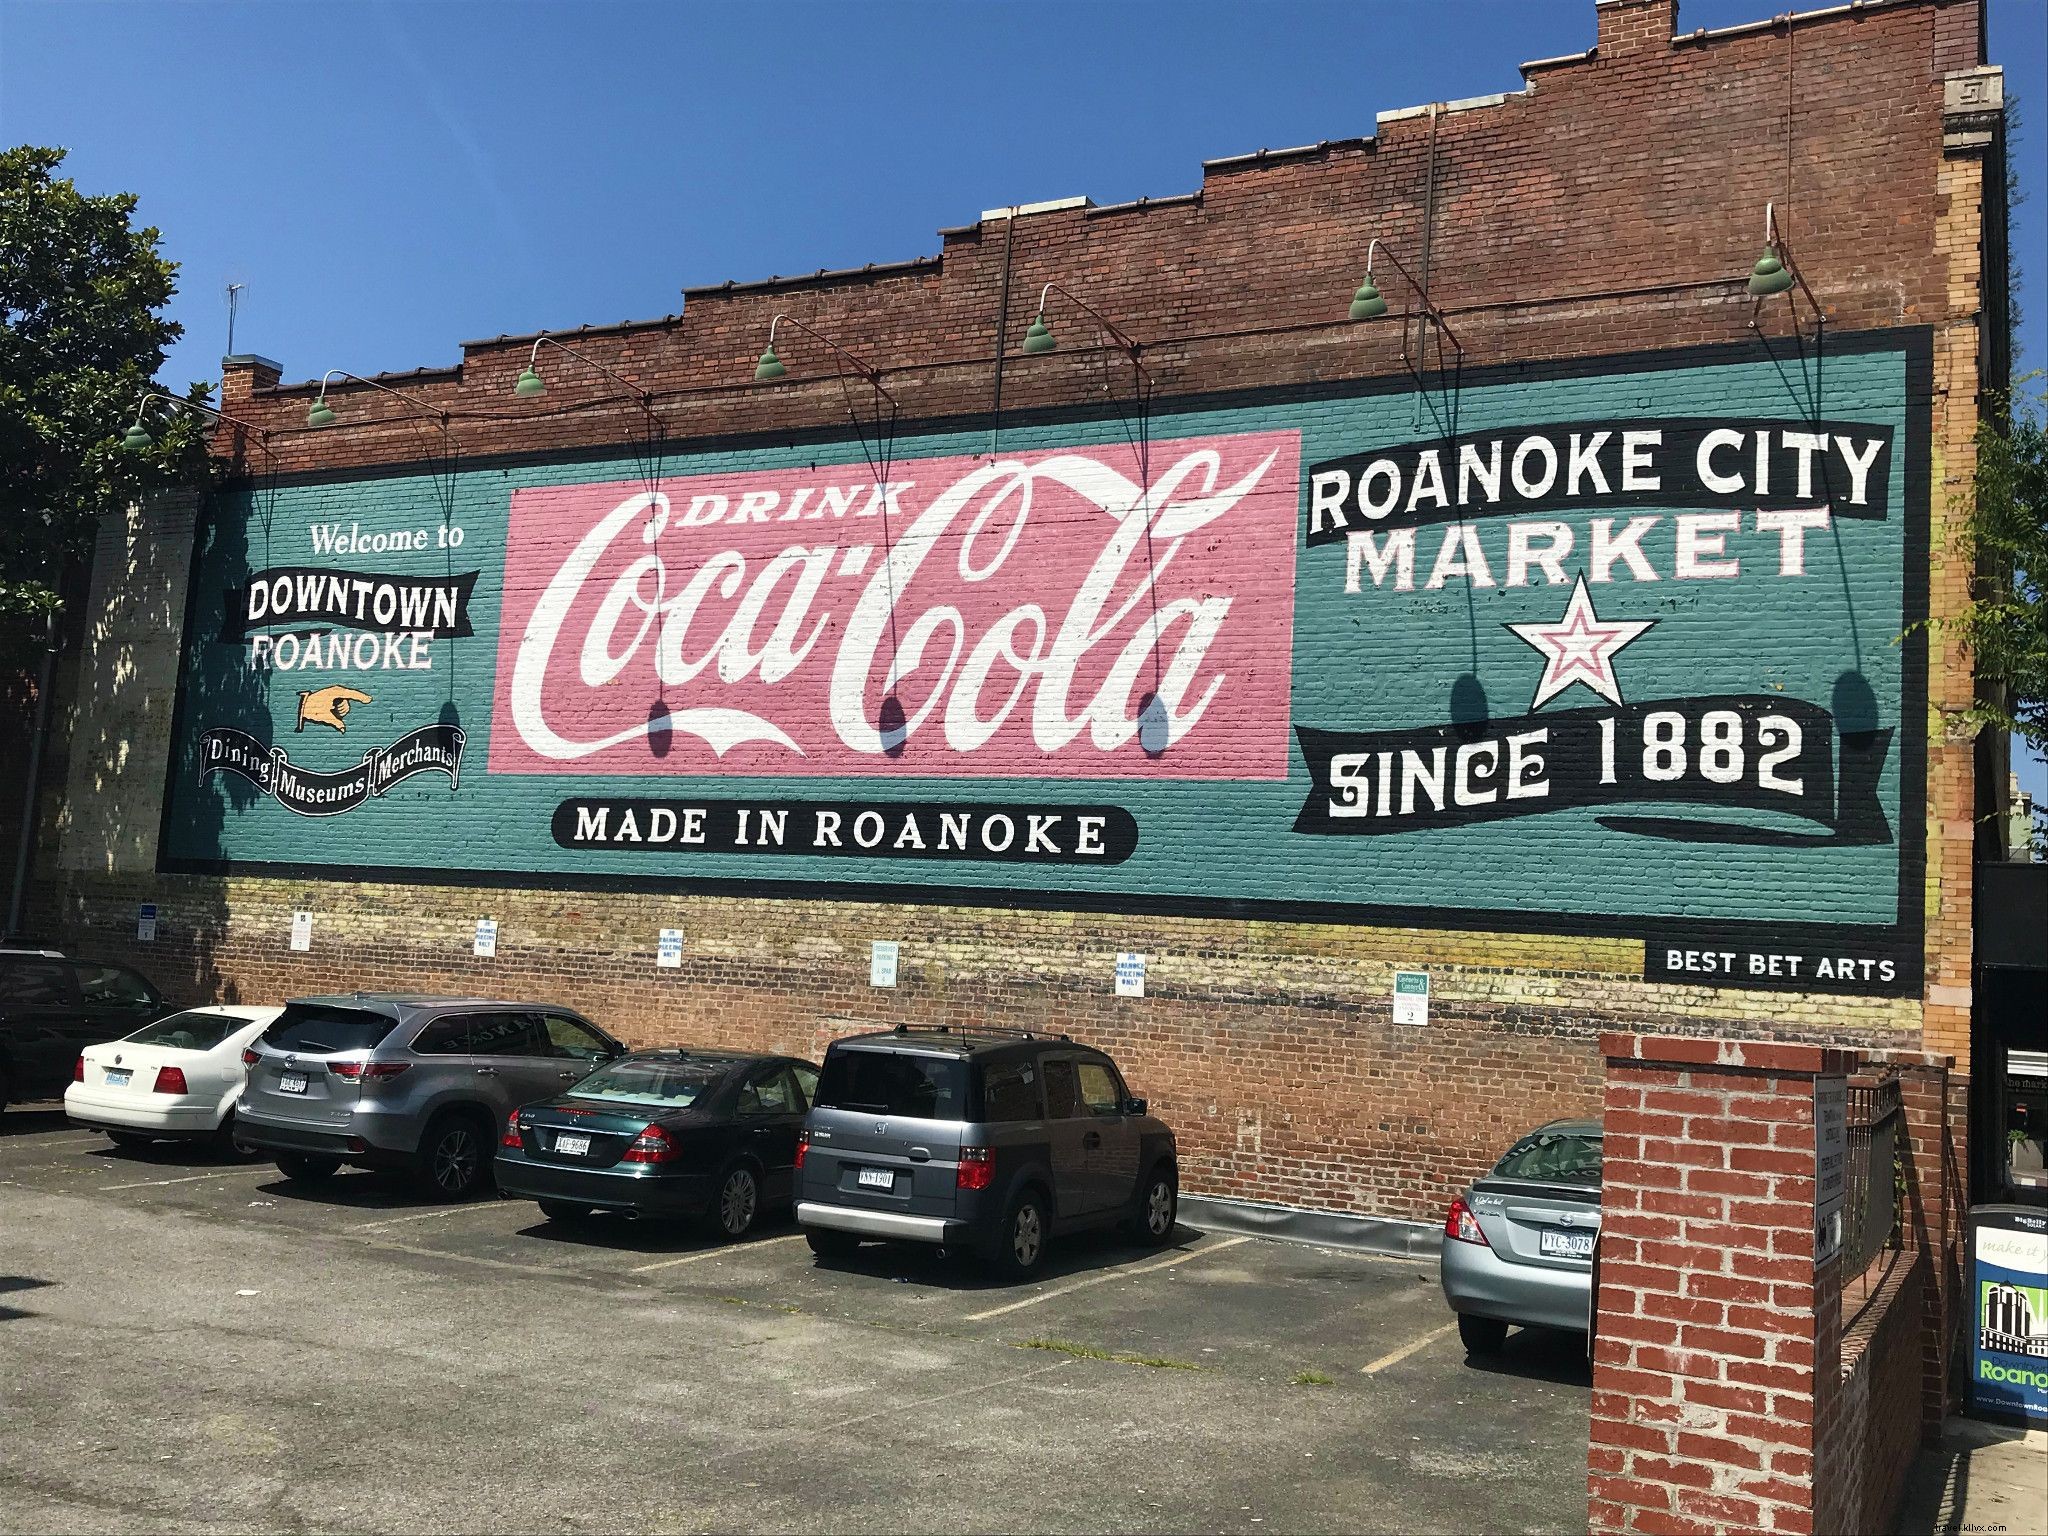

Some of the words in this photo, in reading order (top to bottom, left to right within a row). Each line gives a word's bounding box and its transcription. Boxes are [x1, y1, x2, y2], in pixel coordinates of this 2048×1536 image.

[675, 481, 916, 527] DRINK
[1309, 428, 1662, 536] ROANOKE
[1696, 428, 1885, 506] CITY
[310, 523, 429, 556] Welcome
[438, 524, 464, 549] to
[1343, 504, 1832, 594] MARKET
[248, 575, 459, 628] DOWNTOWN
[512, 447, 1280, 760] Coca-Cola
[251, 629, 435, 671] ROANOKE
[211, 737, 271, 782] Dining
[280, 769, 365, 804] Museums
[377, 739, 454, 785] Merchants
[1329, 727, 1549, 818] SINCE
[1598, 710, 1803, 796] 1882
[574, 807, 707, 844] MADE
[734, 809, 789, 846] IN
[813, 810, 1107, 855] ROANOKE
[1667, 950, 1736, 973] BEST
[1749, 953, 1803, 977] BET
[1816, 957, 1896, 982] ARTS
[1544, 1233, 1590, 1251] VYC-3078
[2014, 1216, 2047, 1226] BigBelly
[1982, 1240, 2021, 1255] make
